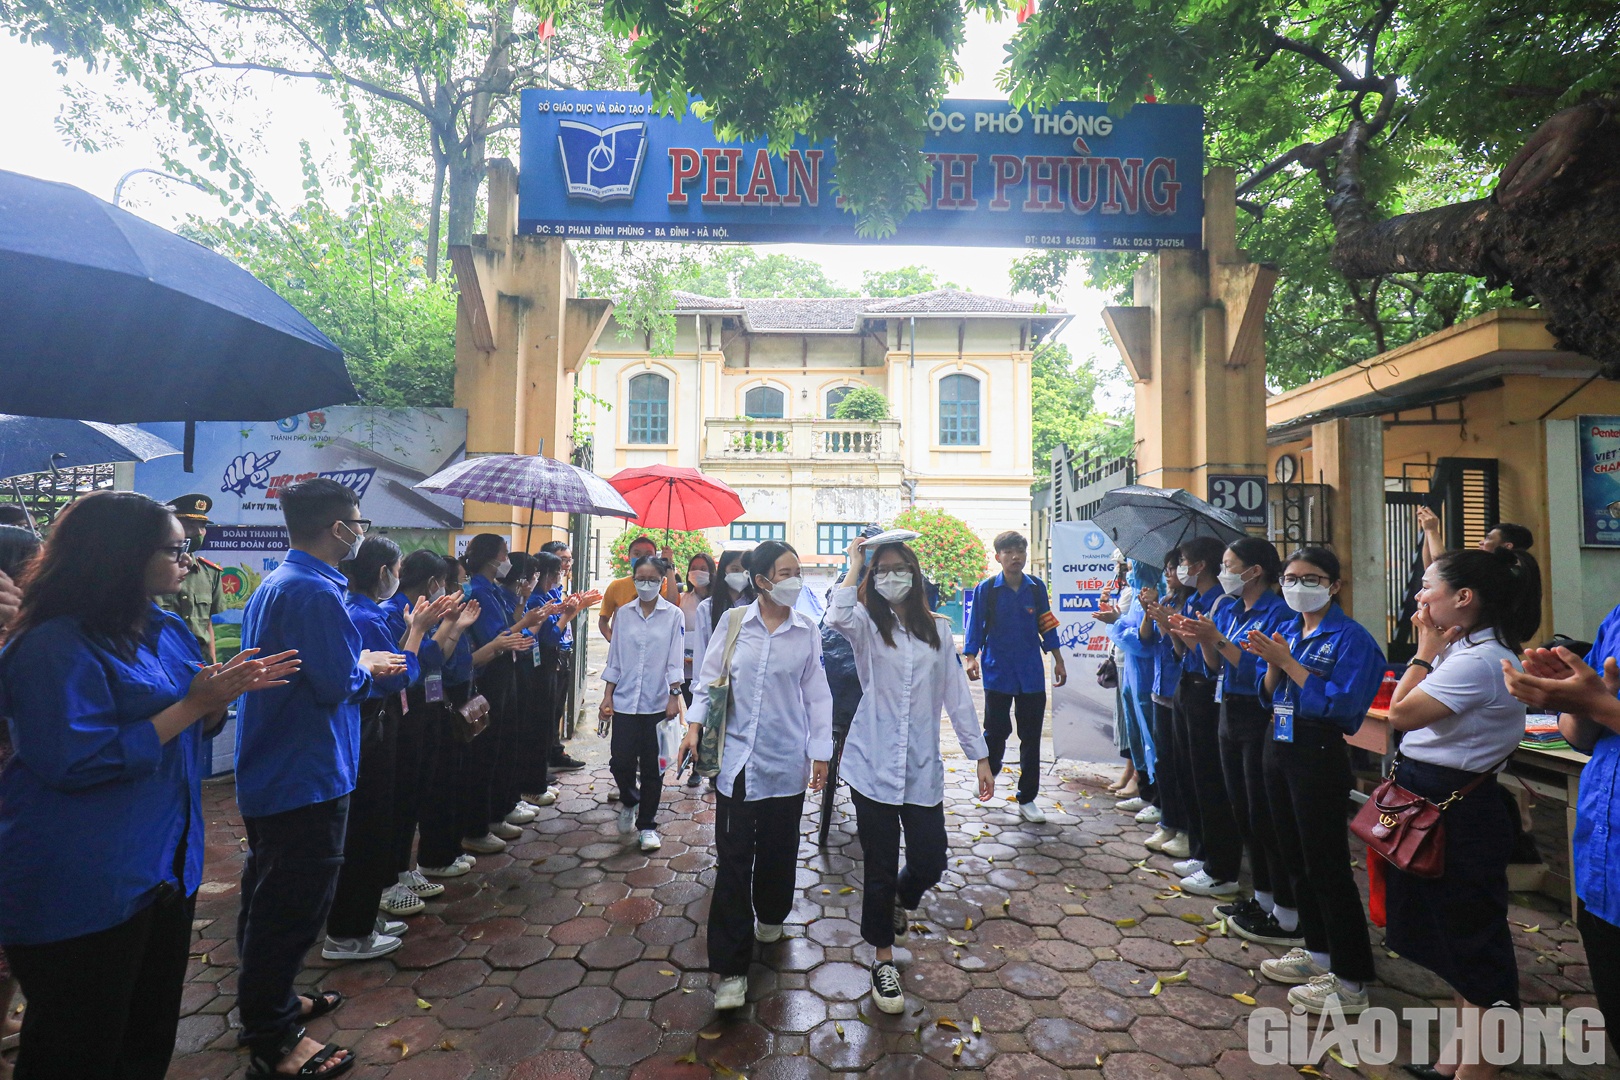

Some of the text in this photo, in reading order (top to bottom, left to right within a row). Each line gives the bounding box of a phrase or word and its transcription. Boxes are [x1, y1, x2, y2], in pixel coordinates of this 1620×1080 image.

[538, 100, 550, 111] SỞ
[553, 101, 574, 112] GIÁO
[576, 103, 593, 115] DỤC
[596, 102, 606, 113] VÀ
[609, 102, 626, 113] ĐÀO
[629, 104, 645, 116] TẠO
[922, 111, 966, 137] ỌC
[1032, 110, 1113, 136] THÔNG
[667, 147, 824, 207] PHAN
[990, 136, 1182, 215] PHÙNG
[536, 225, 551, 234] ĐC:
[555, 225, 565, 234] 30
[568, 226, 591, 235] PHAN
[594, 224, 613, 235] ĐÌNH
[617, 225, 644, 236] PHÙNG
[655, 228, 666, 236] BA
[670, 226, 689, 237] ĐÌNH
[697, 227, 708, 237] HÀ
[1025, 235, 1038, 244] ĐT:
[1041, 236, 1061, 244] 0243
[1066, 236, 1096, 245] 8452811
[1113, 237, 1130, 246] FAX:
[1133, 238, 1152, 247] 0243
[1155, 238, 1184, 247] 7347154
[1213, 480, 1263, 510] 30
[223, 529, 247, 538] ĐOÀN
[250, 530, 278, 538] THANH
[241, 540, 265, 548] ĐOÀN
[1062, 563, 1115, 573] CHƯƠNG
[1076, 577, 1104, 590] TIẾP
[1062, 595, 1092, 608] MÙA
